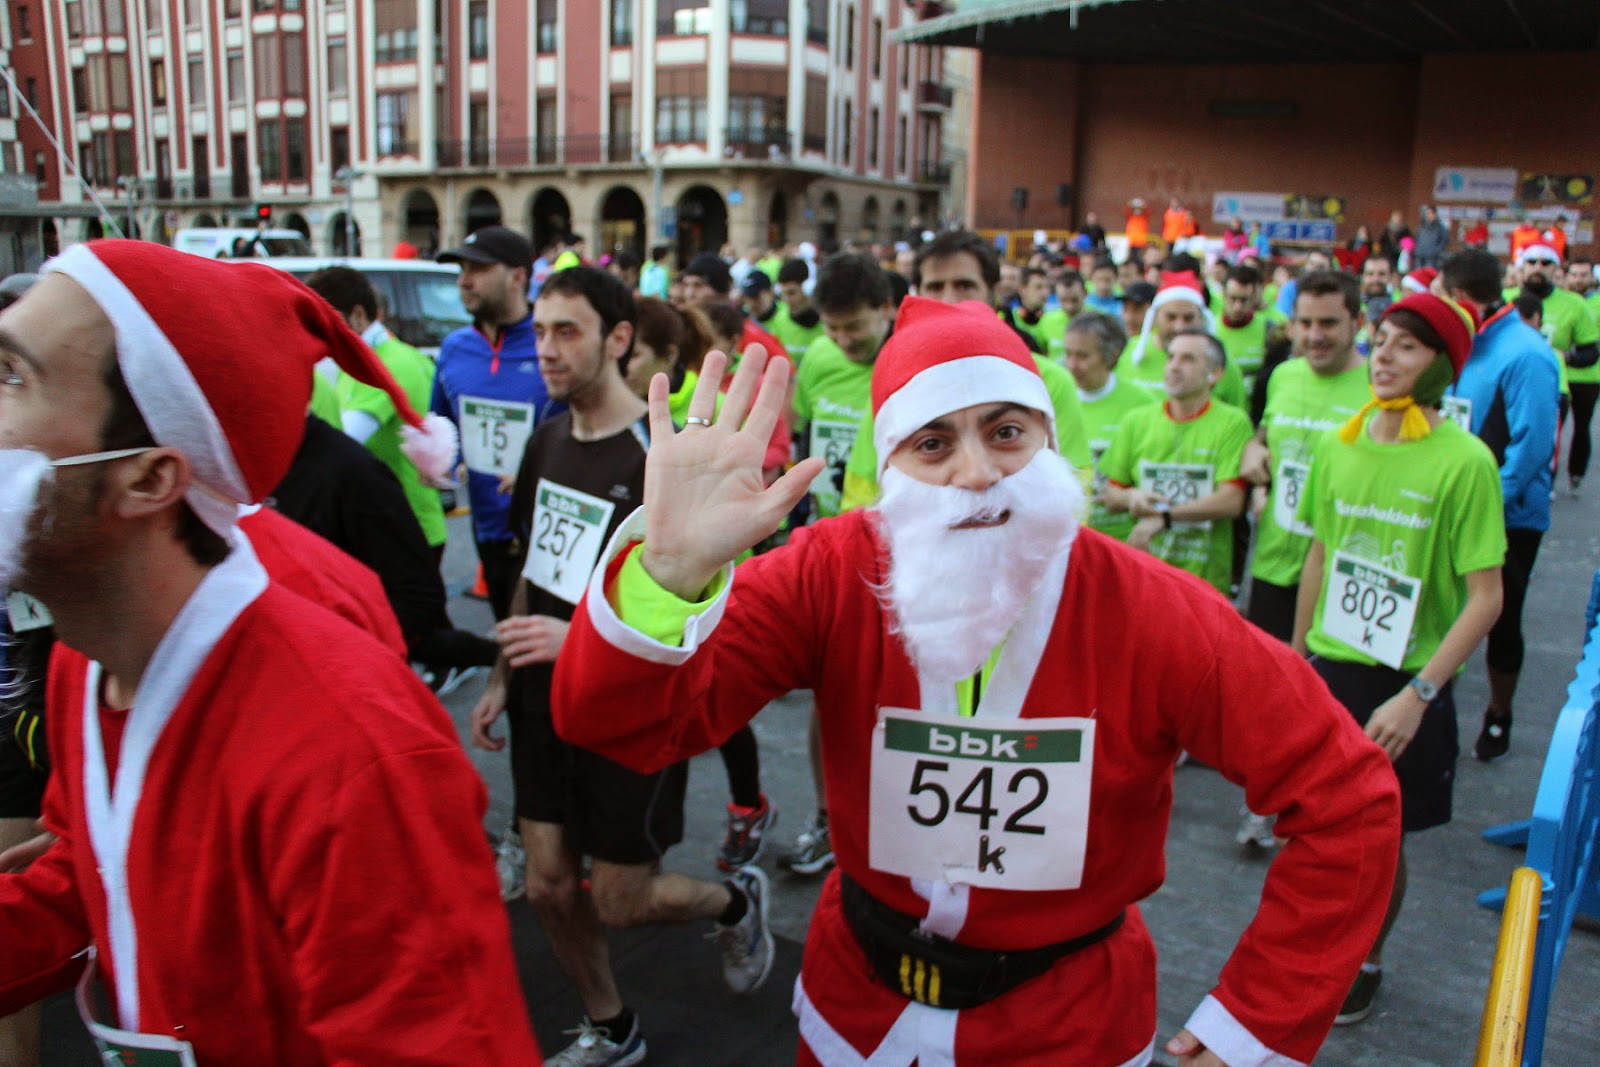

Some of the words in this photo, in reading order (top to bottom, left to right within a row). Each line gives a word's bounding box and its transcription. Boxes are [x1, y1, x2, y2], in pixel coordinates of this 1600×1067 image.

[480, 420, 508, 450] 15
[536, 511, 586, 561] 257
[553, 562, 564, 584] k
[1341, 580, 1398, 631] 802
[1362, 627, 1374, 648] k
[929, 728, 1019, 759] bbk
[907, 759, 1049, 836] 542
[978, 835, 1006, 875] k
